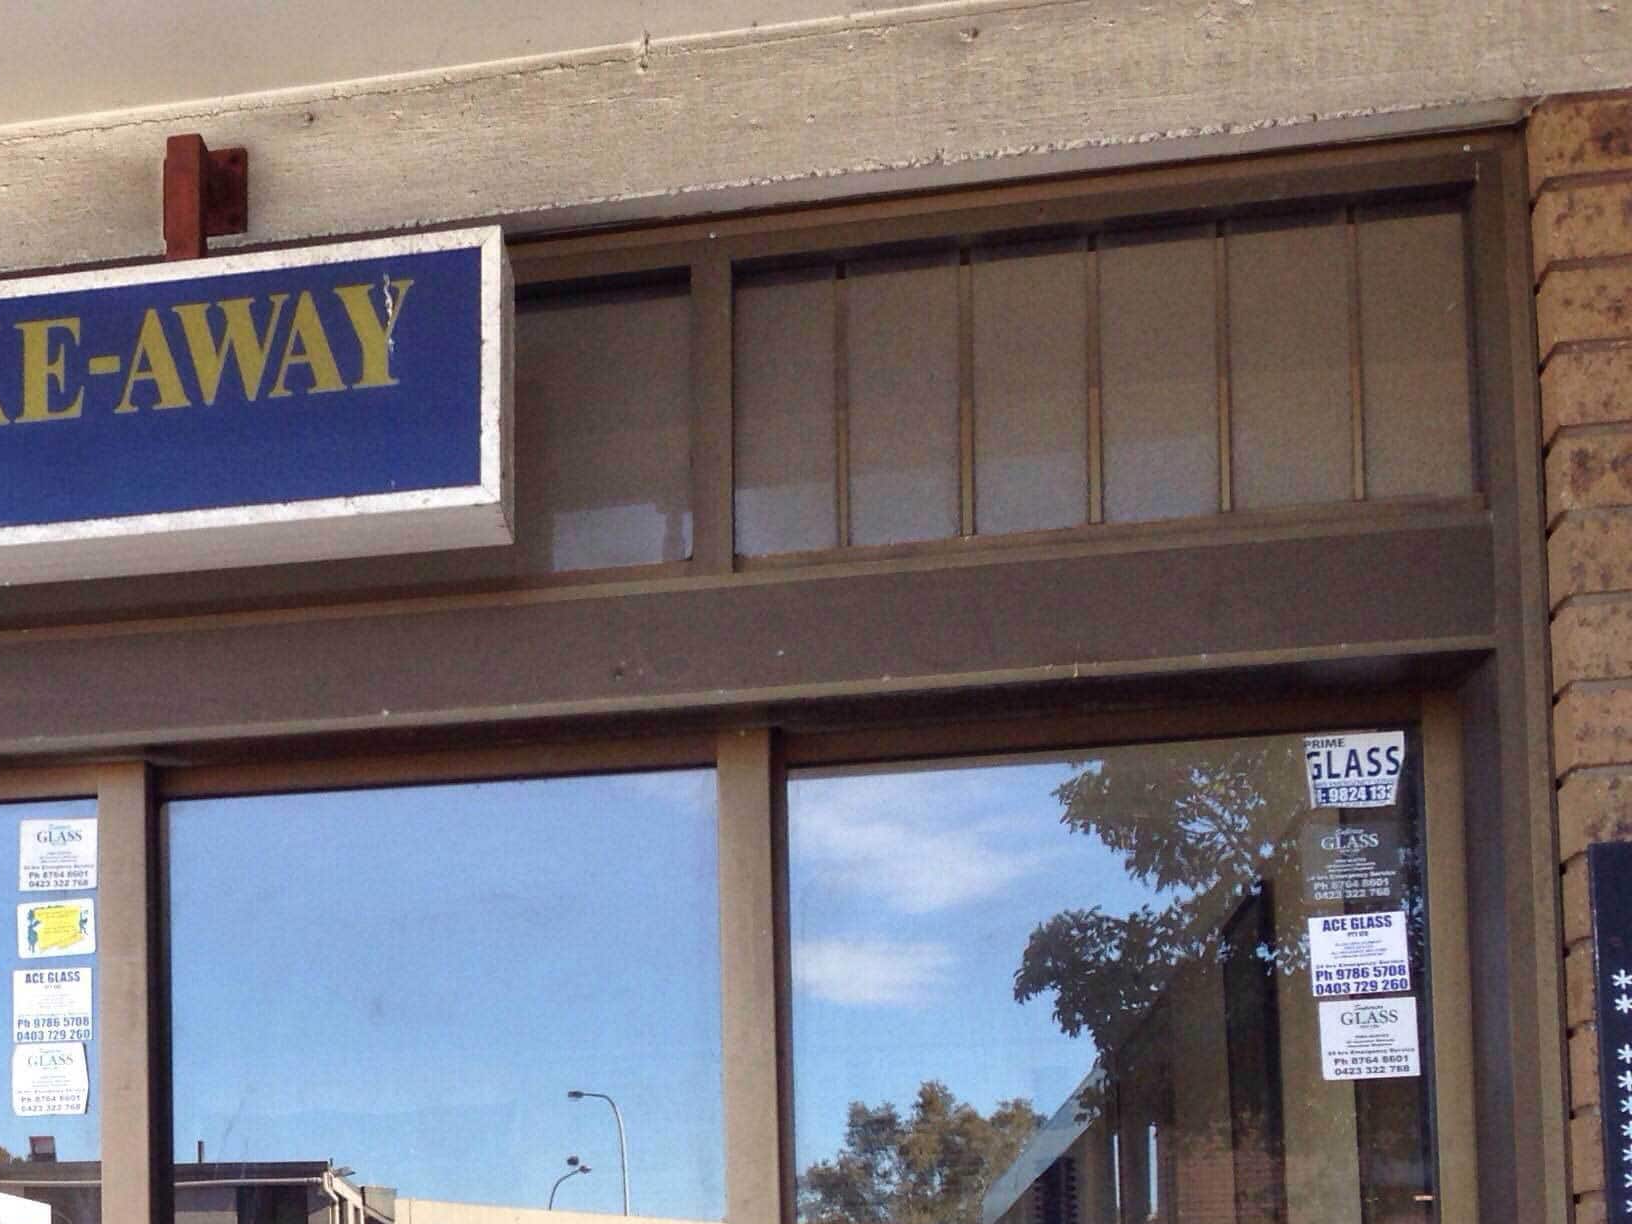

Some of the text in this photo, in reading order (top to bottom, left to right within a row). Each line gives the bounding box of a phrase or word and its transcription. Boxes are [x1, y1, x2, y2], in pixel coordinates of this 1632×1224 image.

[1304, 738, 1345, 749] PRIME
[1307, 746, 1400, 780] GLASS
[1328, 786, 1367, 802] 9824
[37, 830, 82, 842] GLASS
[1321, 833, 1378, 849] GLASS
[1323, 914, 1393, 932] ACE GLASS
[24, 971, 80, 984] ACE GLASS
[1315, 965, 1406, 982] Ph 9786 5708
[1315, 978, 1409, 995] 0403 729 260
[18, 1019, 31, 1029] Ph
[1340, 1009, 1398, 1026] GLASS
[28, 1056, 74, 1066] GLASS
[1334, 1058, 1348, 1066] Ph
